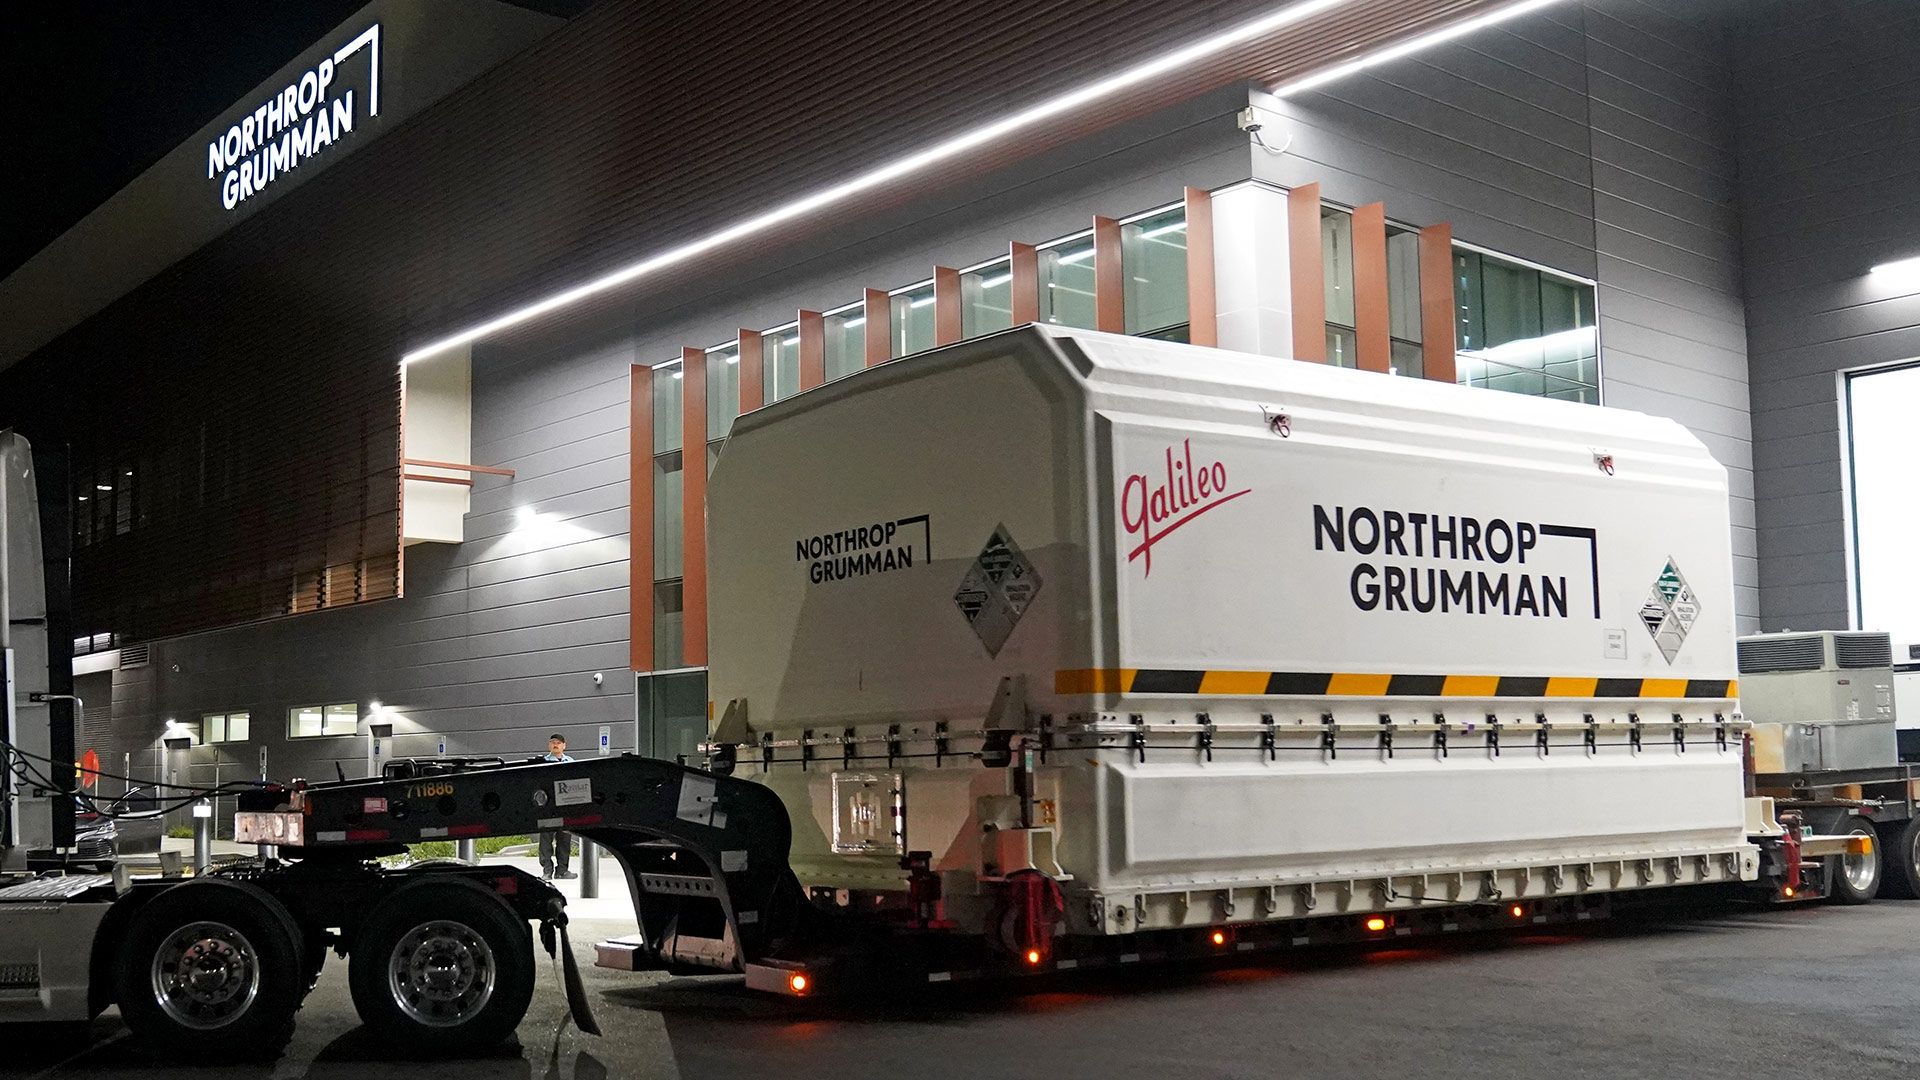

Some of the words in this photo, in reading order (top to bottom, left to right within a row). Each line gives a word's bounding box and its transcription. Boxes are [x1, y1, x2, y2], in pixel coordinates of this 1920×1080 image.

[208, 58, 334, 179] NORTHROP
[222, 89, 353, 210] GRUMMAN
[796, 521, 896, 562] NORTHROP
[1313, 504, 1537, 564] NORTHROP
[810, 545, 913, 585] GRUMMAN
[1350, 562, 1568, 618] GRUMMAN
[405, 781, 454, 799] 711886
